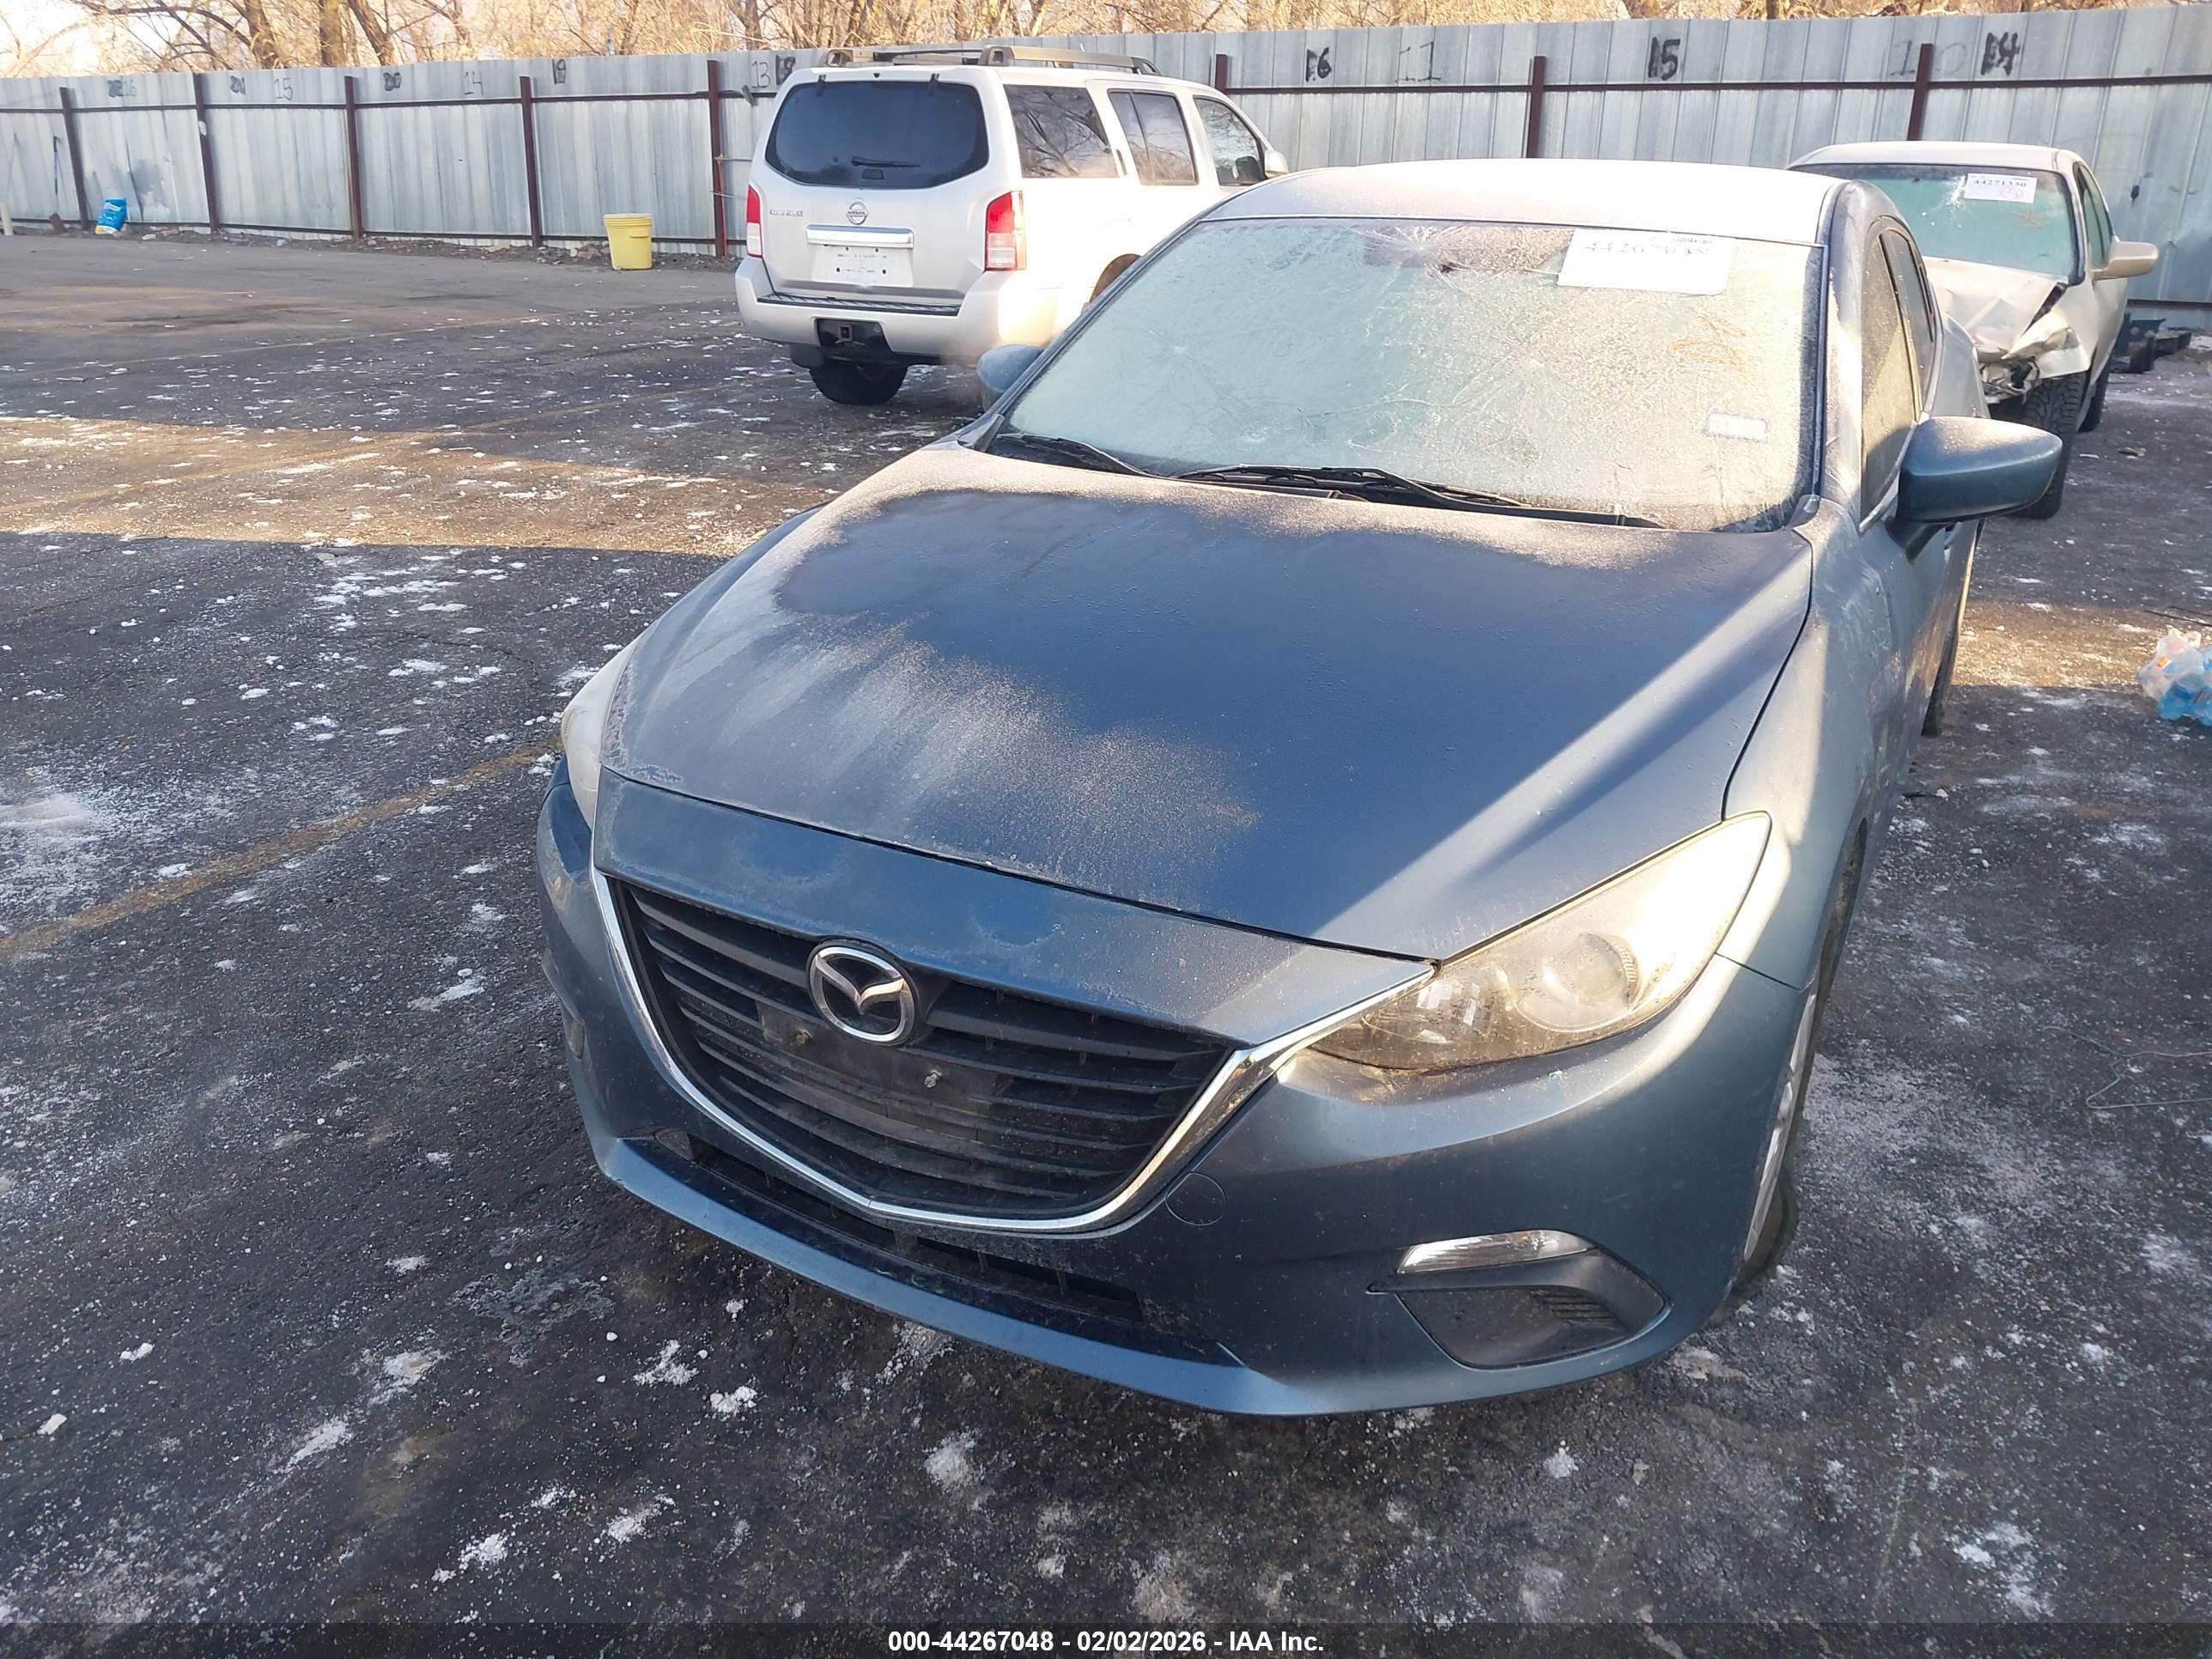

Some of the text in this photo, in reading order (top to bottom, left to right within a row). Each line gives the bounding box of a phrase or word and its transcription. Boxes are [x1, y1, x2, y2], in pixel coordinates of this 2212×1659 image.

[1648, 36, 1681, 81] 15
[463, 70, 483, 95] 14
[751, 60, 771, 88] 13
[274, 76, 295, 100] 15
